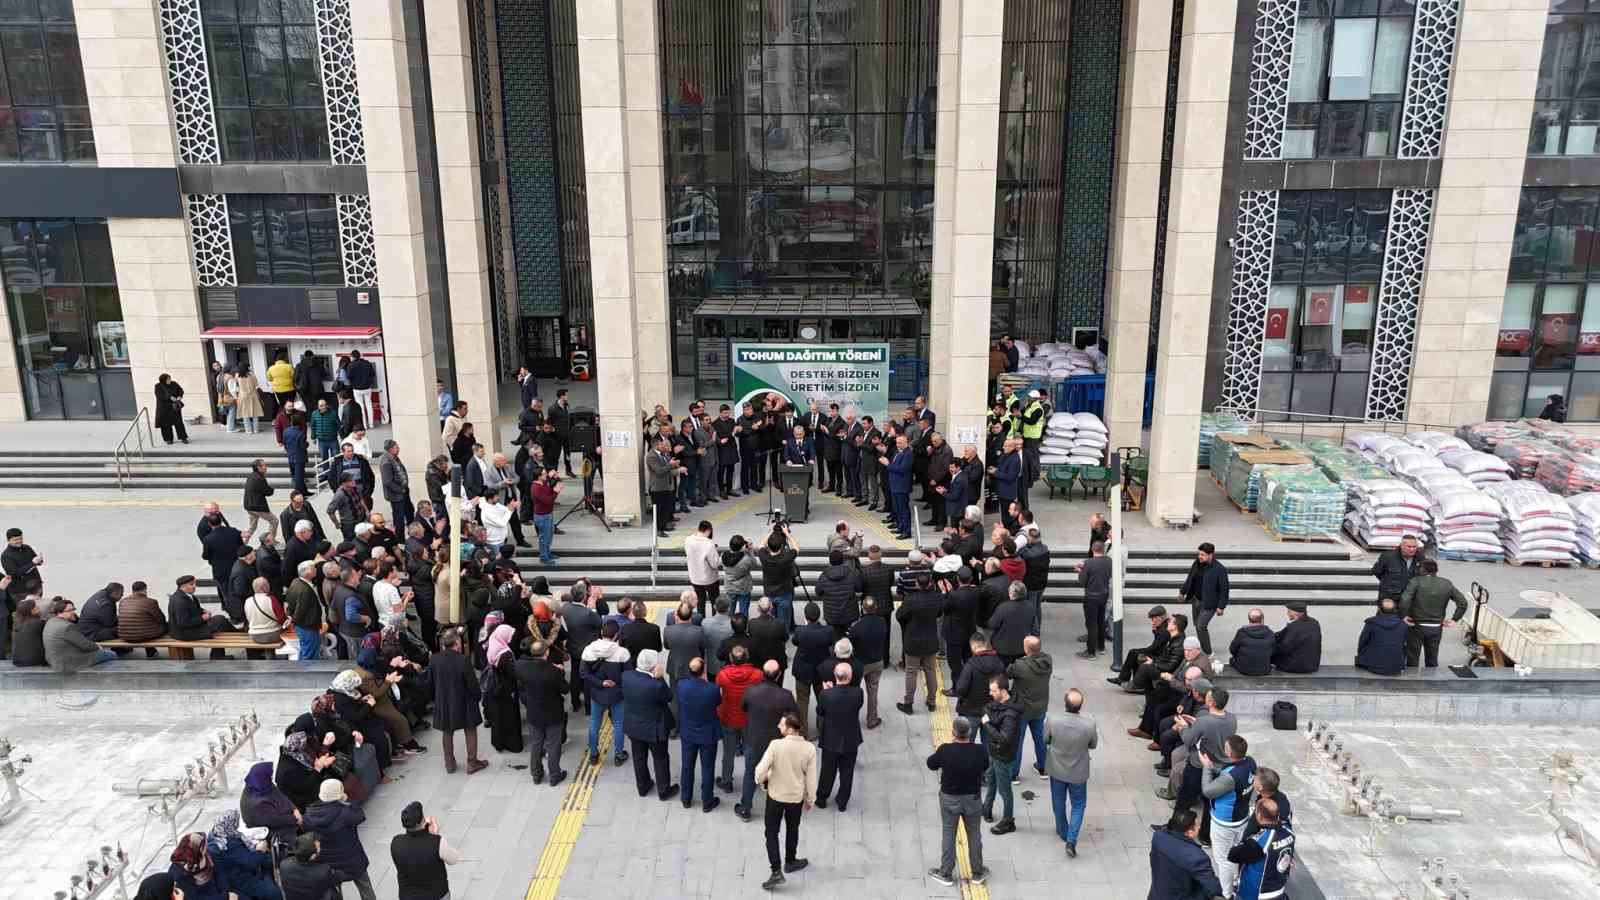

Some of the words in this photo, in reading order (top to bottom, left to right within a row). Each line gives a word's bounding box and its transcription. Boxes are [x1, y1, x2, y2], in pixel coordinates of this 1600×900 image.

[741, 351, 784, 361] TOHUM
[786, 349, 836, 361] DAĞITIM
[838, 348, 881, 361] TÖRENİ
[790, 370, 834, 379] DESTEK
[838, 368, 880, 379] BİZDEN
[790, 381, 835, 392] ÜRETİM
[838, 381, 879, 392] SİZDEN
